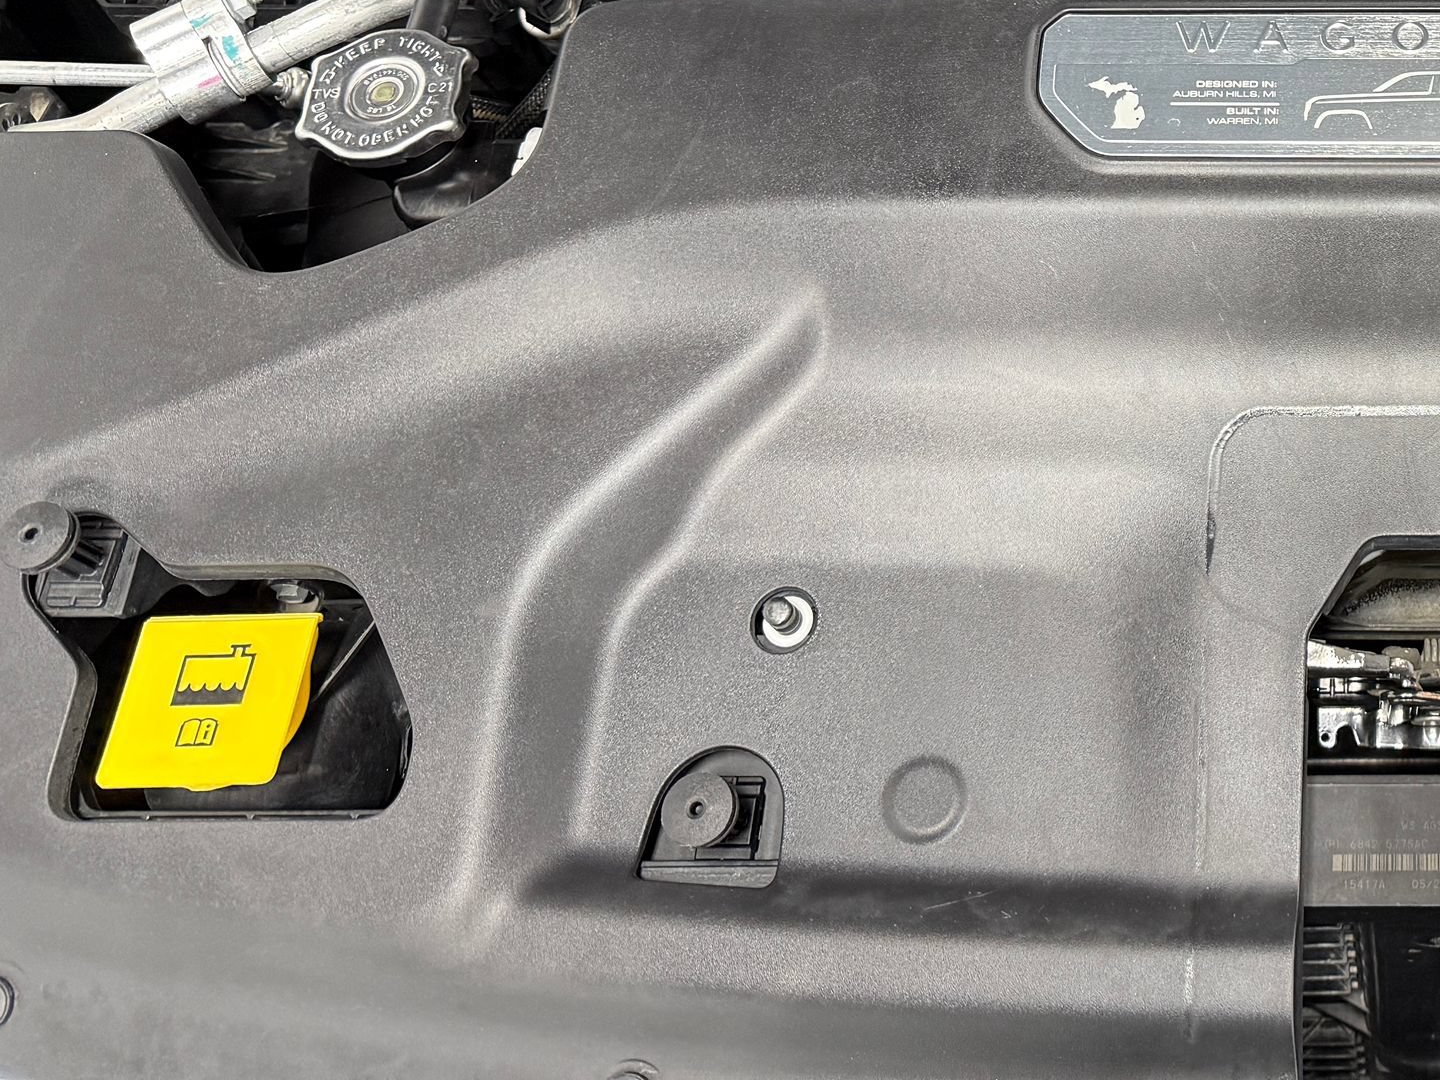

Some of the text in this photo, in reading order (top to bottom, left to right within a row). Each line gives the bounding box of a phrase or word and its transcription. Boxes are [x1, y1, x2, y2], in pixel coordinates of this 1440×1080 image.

[1196, 80, 1278, 88] DESIGNED IN:
[312, 86, 341, 100] TVS
[1172, 90, 1276, 98] AUBURN HILLS, MI
[1226, 107, 1280, 115] BUILT IN:
[312, 101, 328, 123] DO
[358, 124, 409, 147] OPEN
[1206, 117, 1278, 126] WARREN, MI
